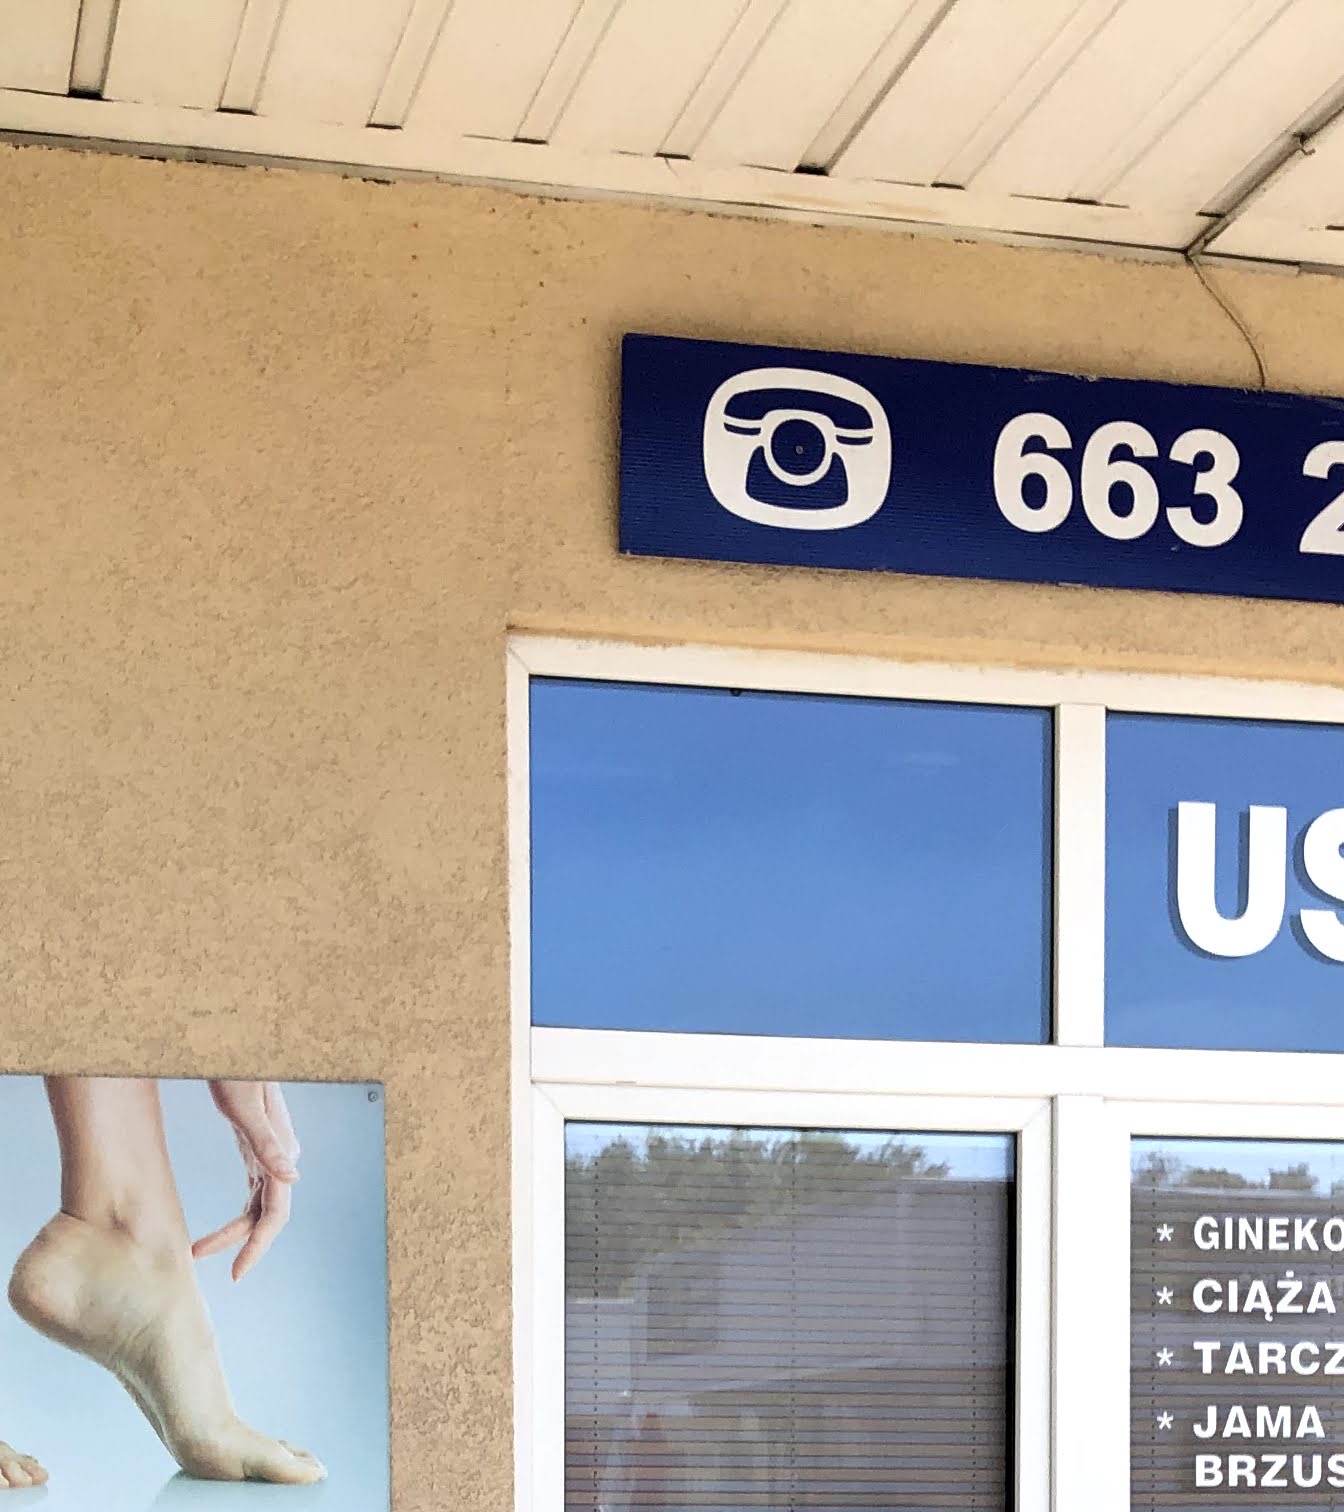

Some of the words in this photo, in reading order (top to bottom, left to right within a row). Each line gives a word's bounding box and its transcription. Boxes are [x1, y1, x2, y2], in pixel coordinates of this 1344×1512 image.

[993, 412, 1243, 547] 663
[1192, 1270, 1336, 1322] CIĄŻA
[1193, 1405, 1326, 1439] JAMA
